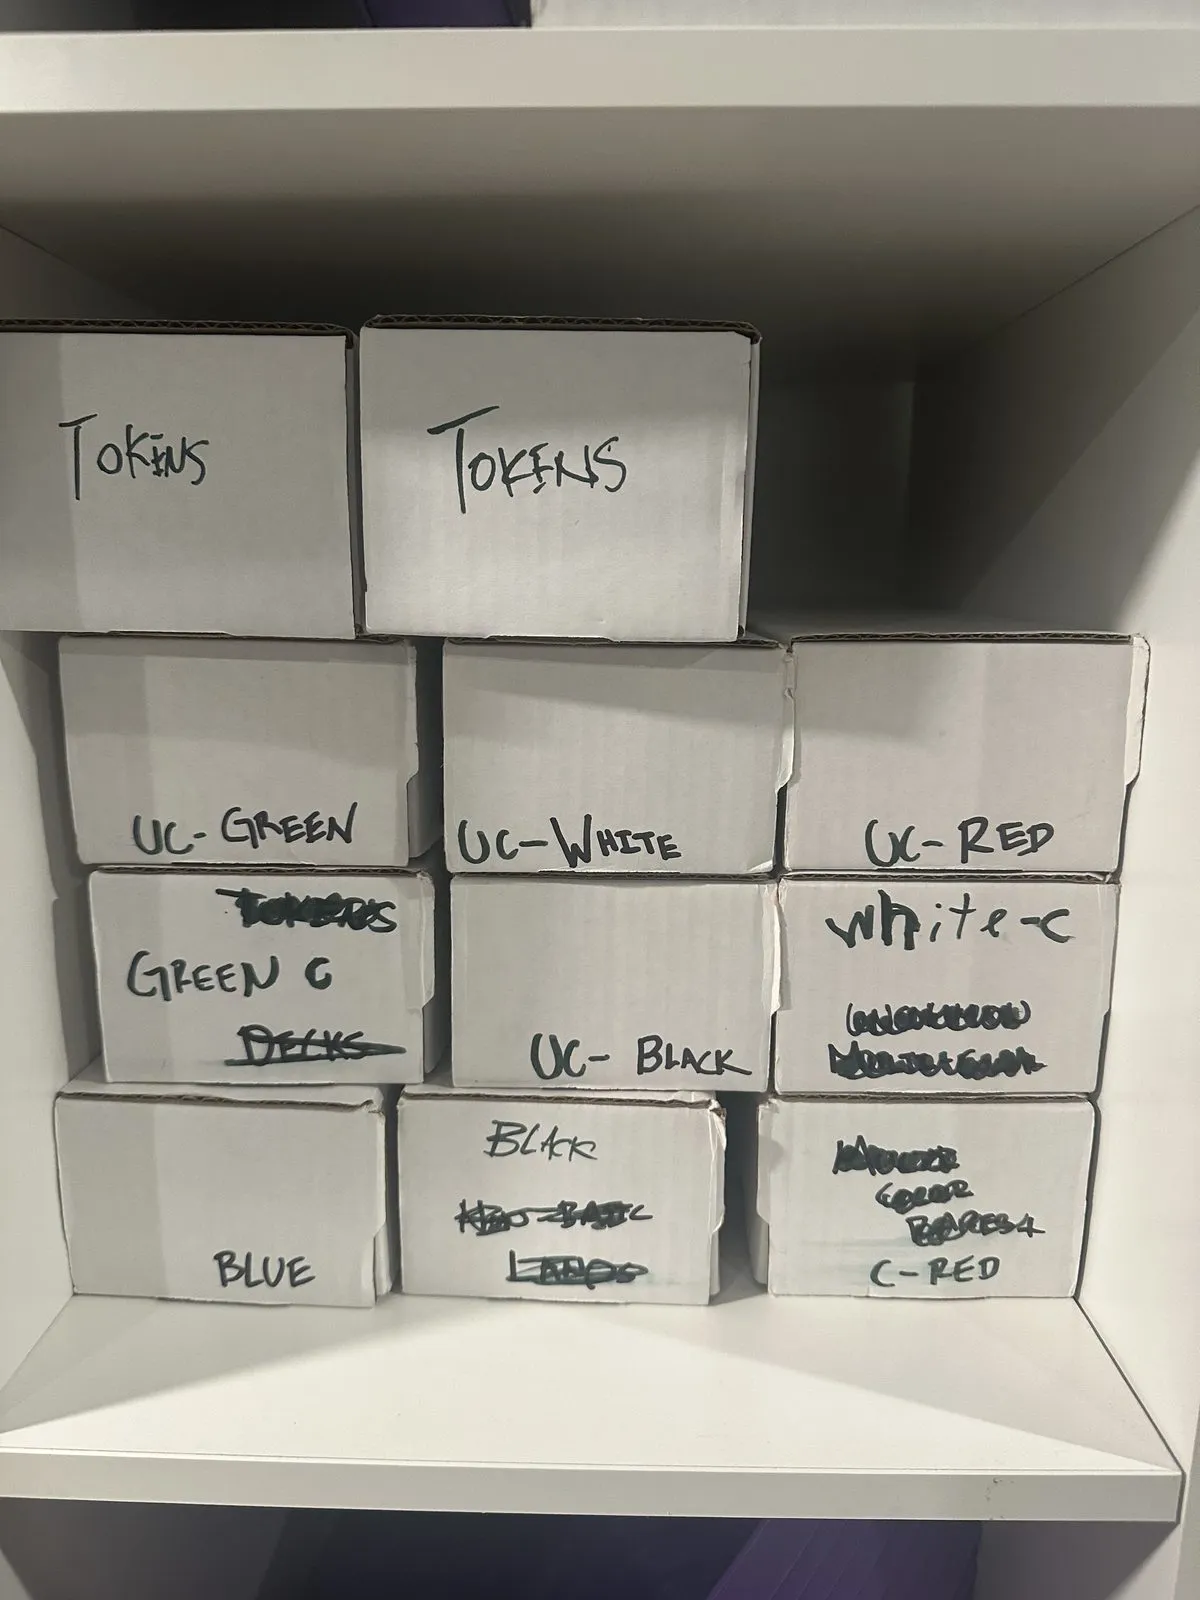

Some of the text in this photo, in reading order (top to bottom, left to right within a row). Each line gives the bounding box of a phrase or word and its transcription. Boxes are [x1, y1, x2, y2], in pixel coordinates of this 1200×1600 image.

[426, 405, 627, 515] TOKENS
[126, 950, 280, 1002] GREEN
[636, 1034, 753, 1076] BLACK
[483, 1119, 598, 1162] BLACK
[213, 1250, 316, 1289] BLUE
